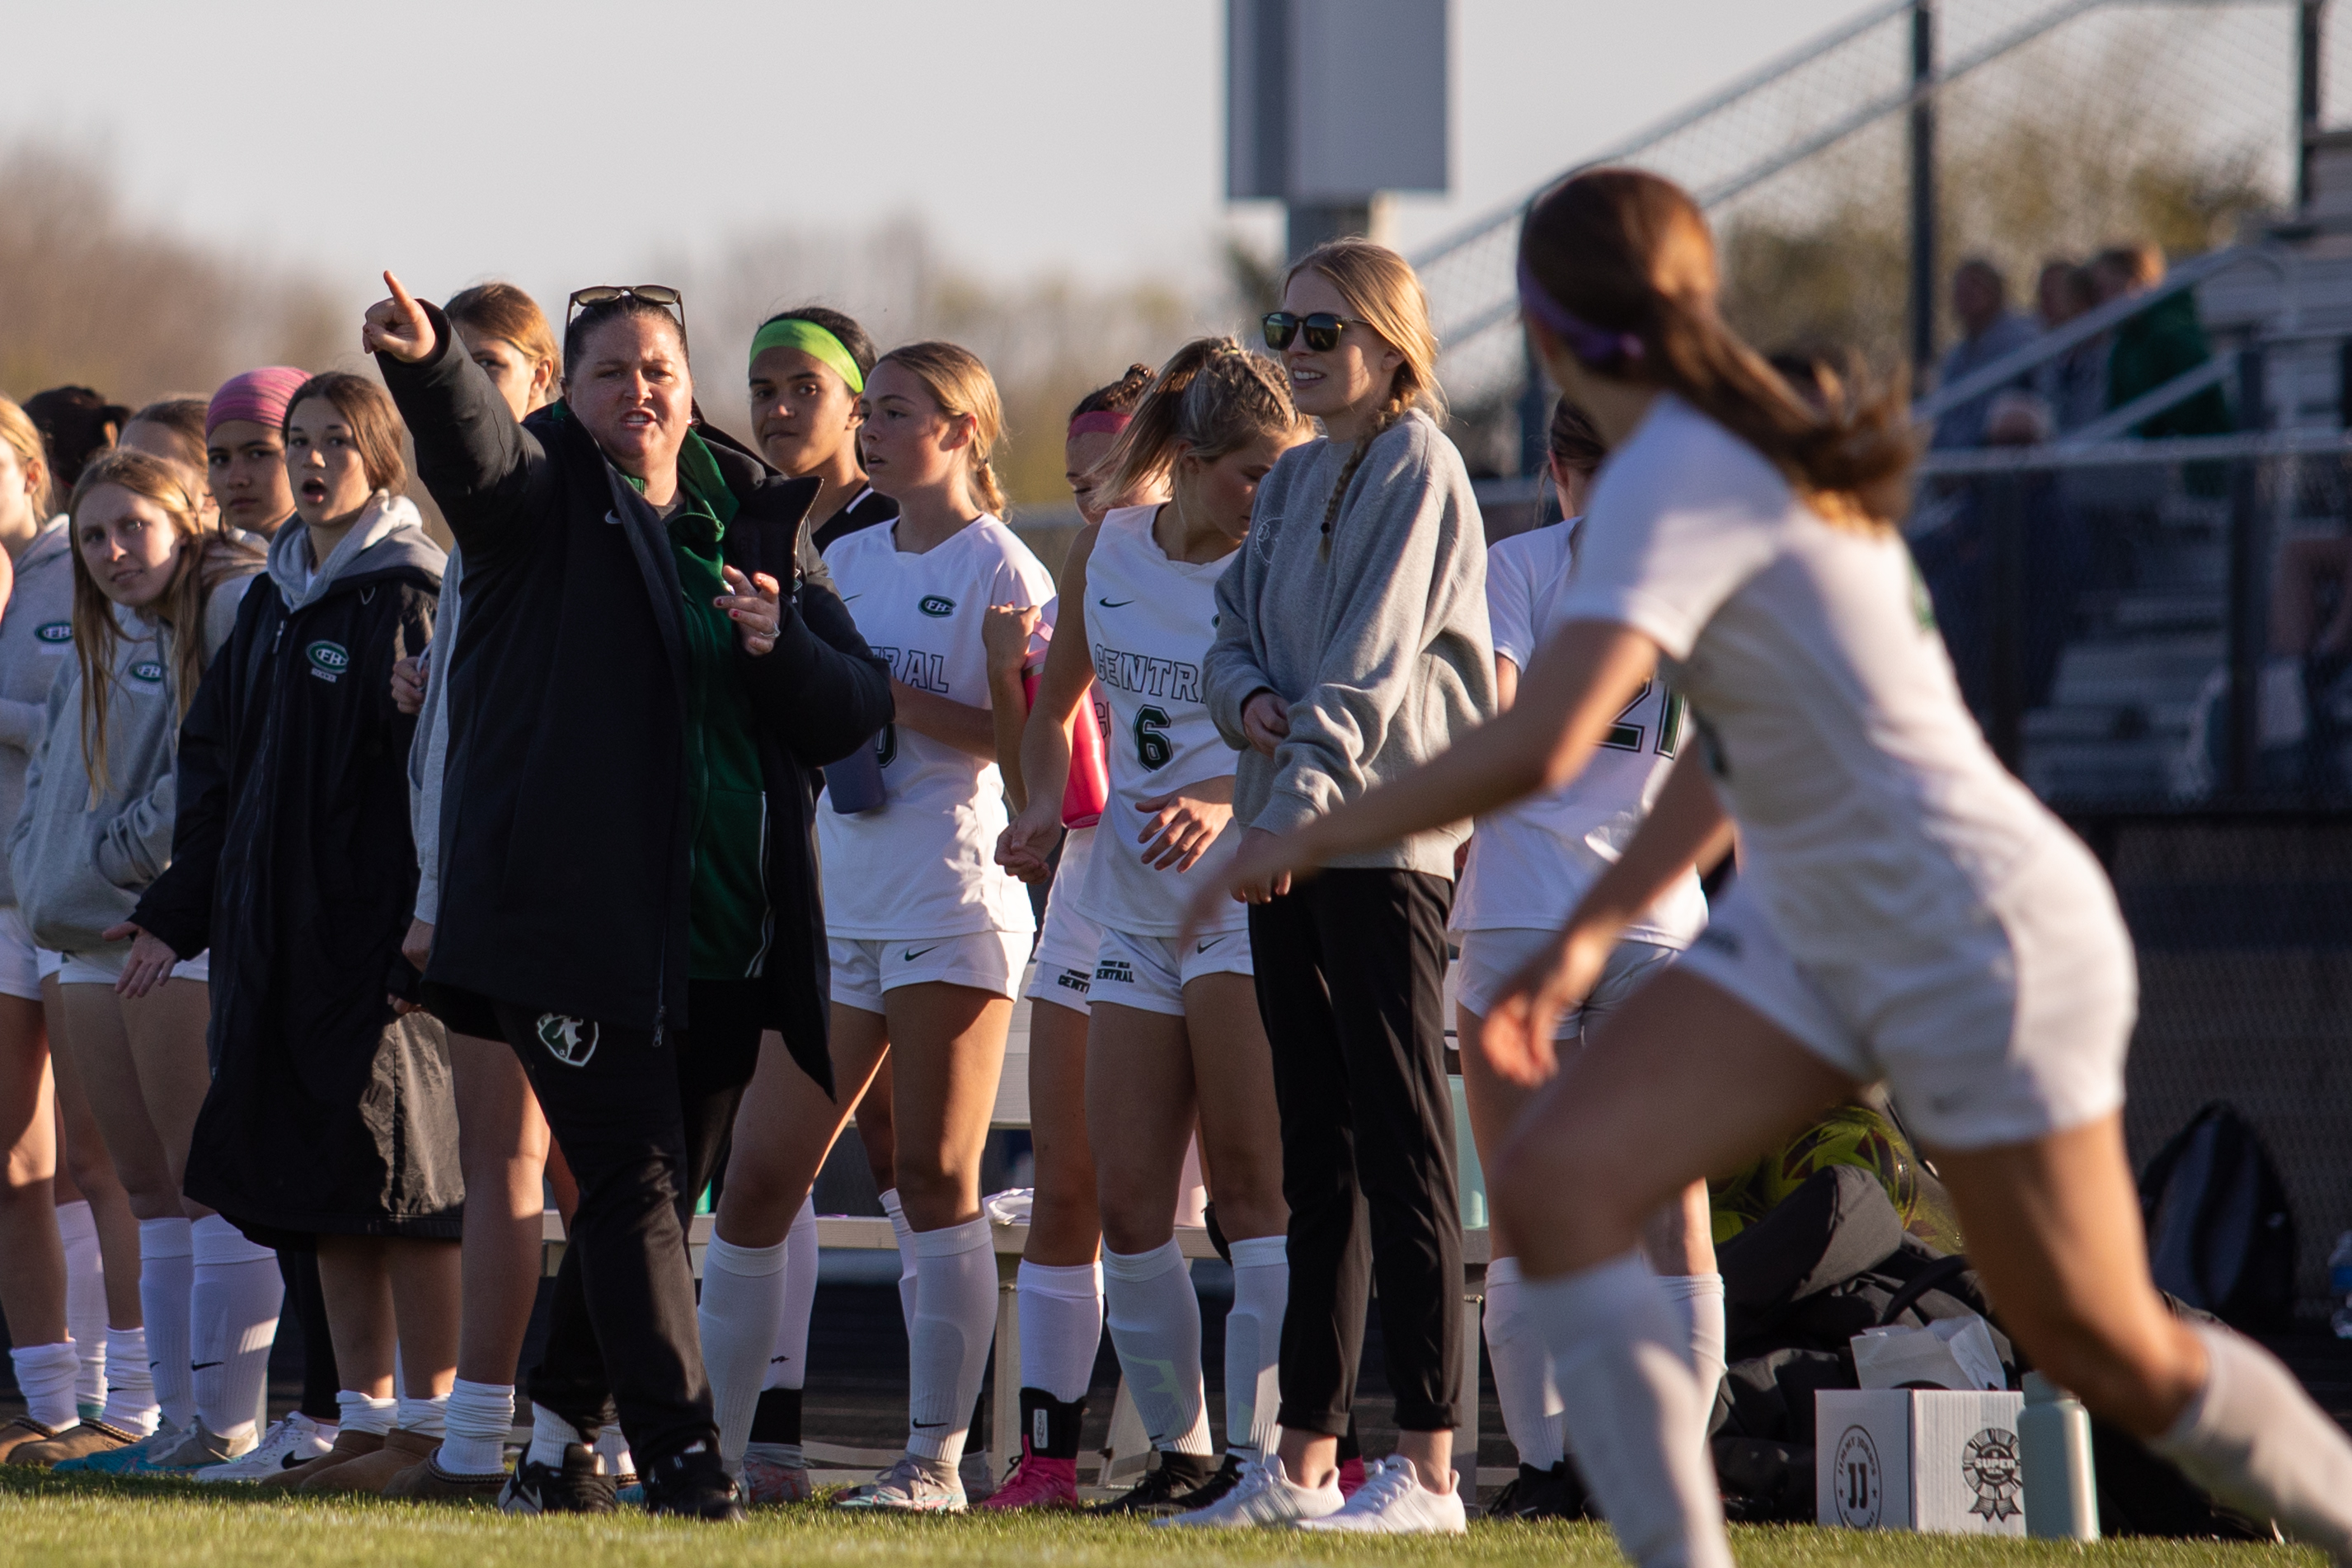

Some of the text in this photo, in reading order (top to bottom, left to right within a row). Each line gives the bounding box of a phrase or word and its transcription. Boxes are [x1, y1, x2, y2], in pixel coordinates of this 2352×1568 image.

[1095, 643, 1205, 705] CENTR
[1134, 704, 1173, 772] 6
[1847, 1462, 1867, 1509] JJ
[1974, 1457, 2016, 1469] SUPER
